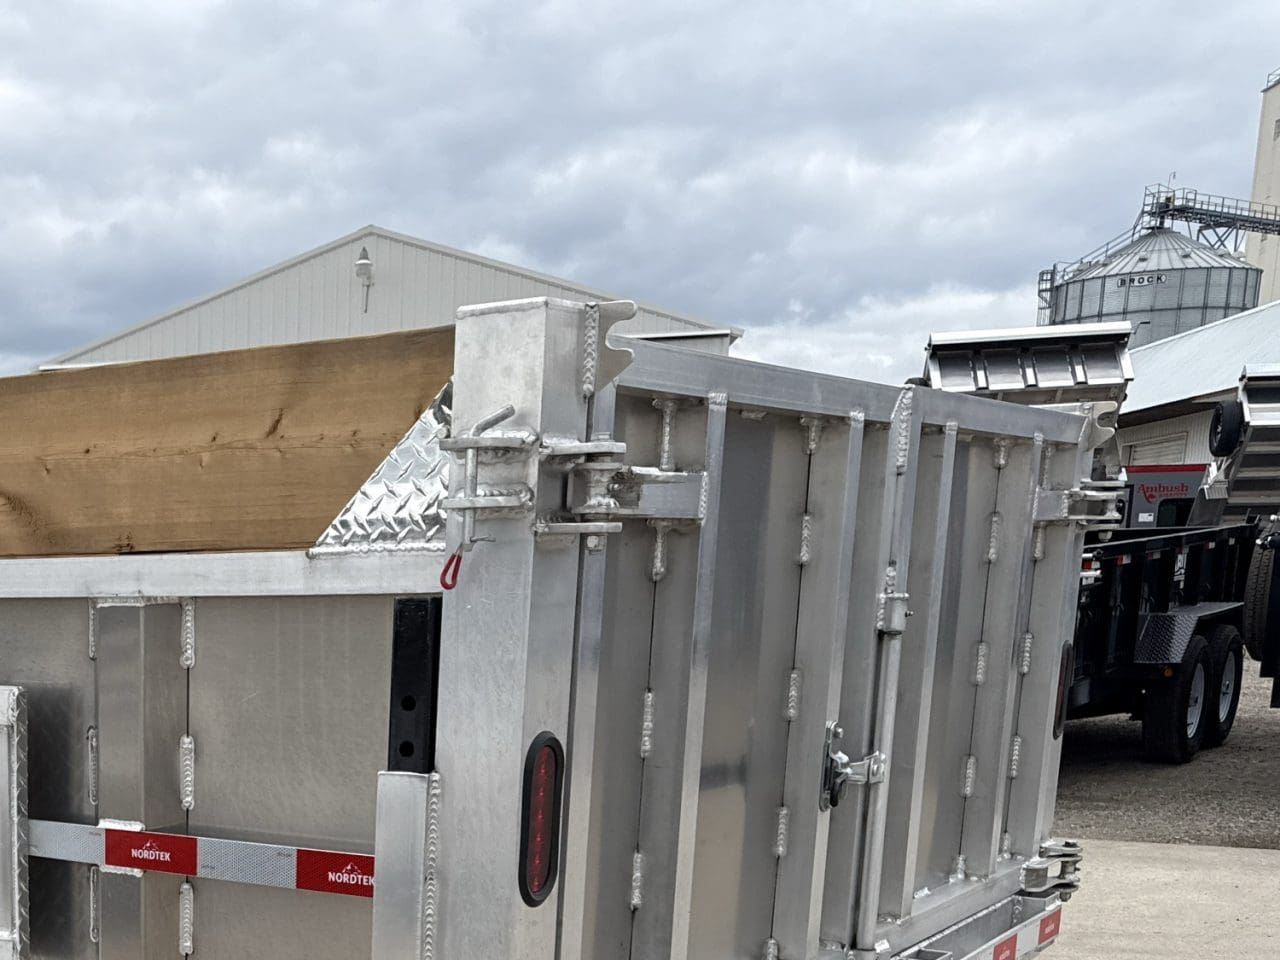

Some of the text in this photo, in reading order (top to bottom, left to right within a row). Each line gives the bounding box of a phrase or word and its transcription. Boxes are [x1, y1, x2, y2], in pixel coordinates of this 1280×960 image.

[1119, 275, 1162, 286] BROCK
[131, 848, 171, 861] NORDTEK
[327, 871, 375, 886] NORDTEK
